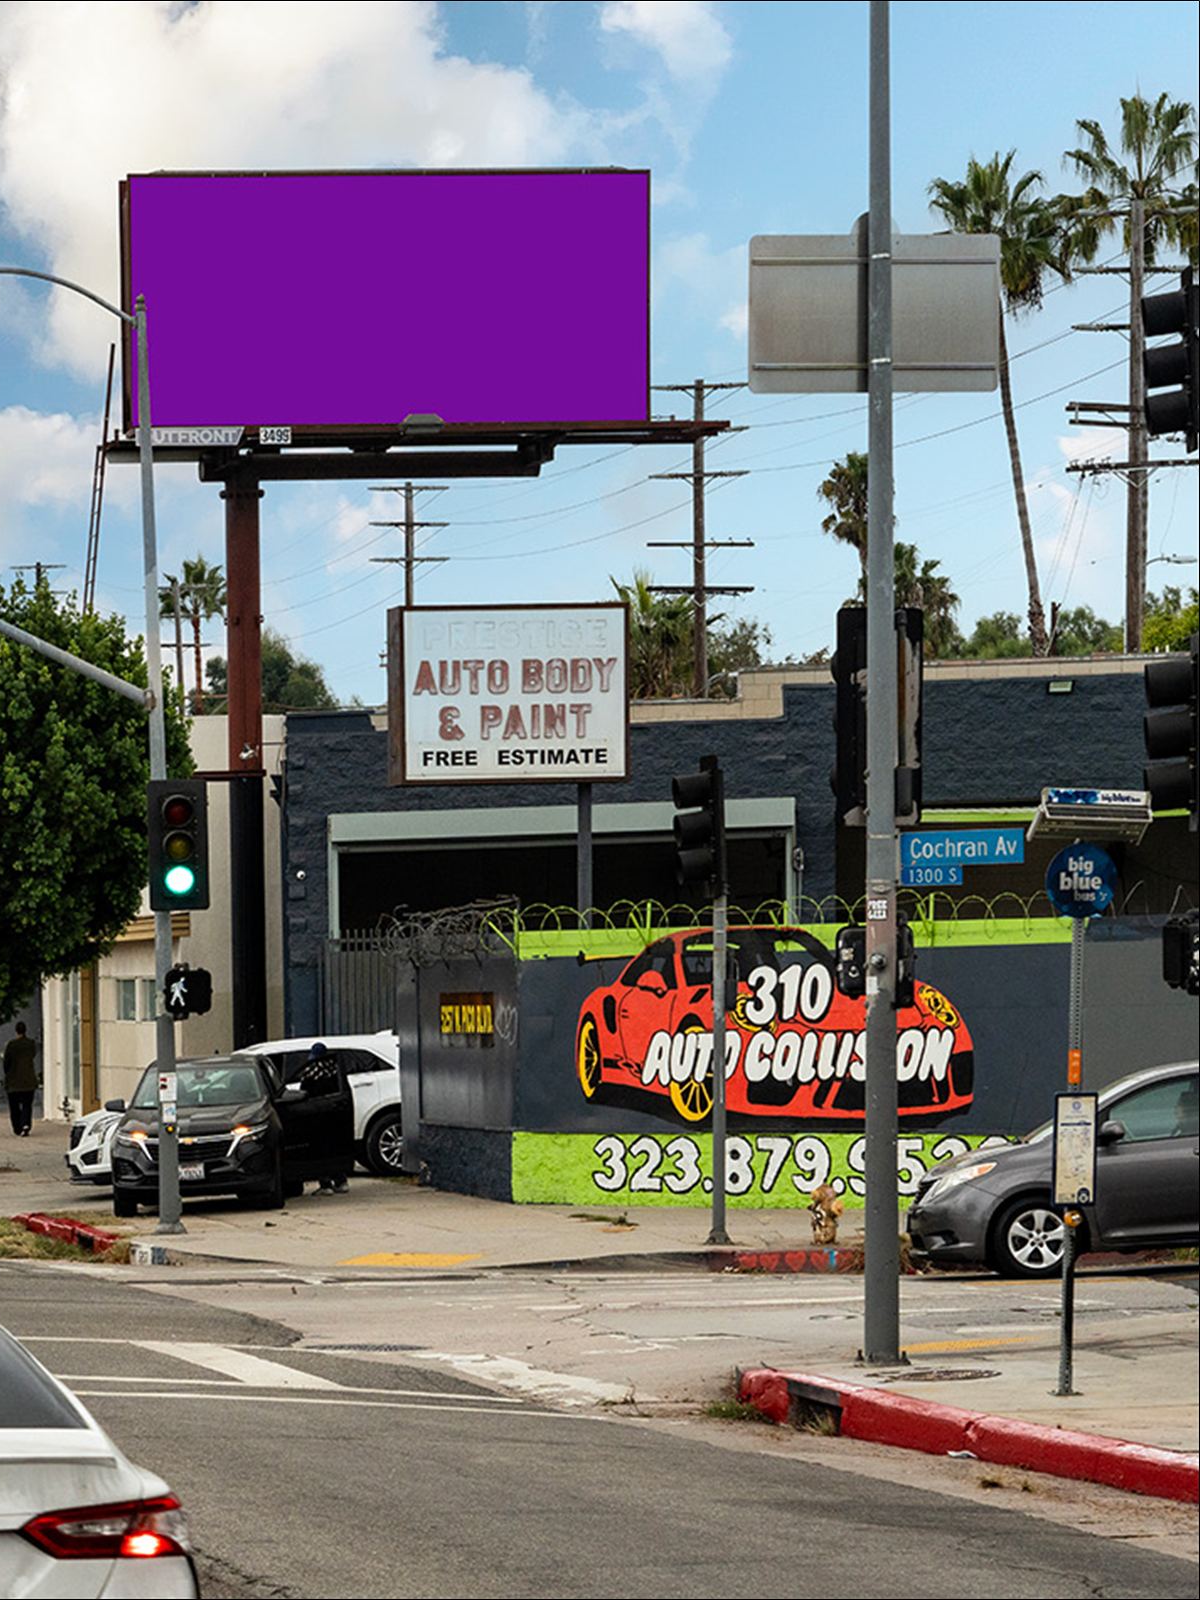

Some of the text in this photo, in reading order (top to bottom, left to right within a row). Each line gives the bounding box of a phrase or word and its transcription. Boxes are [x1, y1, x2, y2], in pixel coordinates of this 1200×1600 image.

[149, 429, 237, 443] UTFRONT
[421, 619, 608, 650] PRESTIGE
[412, 658, 618, 696] AUTO BODY
[438, 703, 593, 741] & PAINT
[422, 748, 608, 767] FREE ESTIMATE
[910, 837, 1018, 860] Cochran Av
[908, 867, 957, 883] 1300 S
[1068, 856, 1094, 875] big
[1059, 872, 1102, 891] blue
[1074, 890, 1096, 901] bus
[744, 963, 833, 1025] 310
[641, 1028, 955, 1085] AUTO COLLISON
